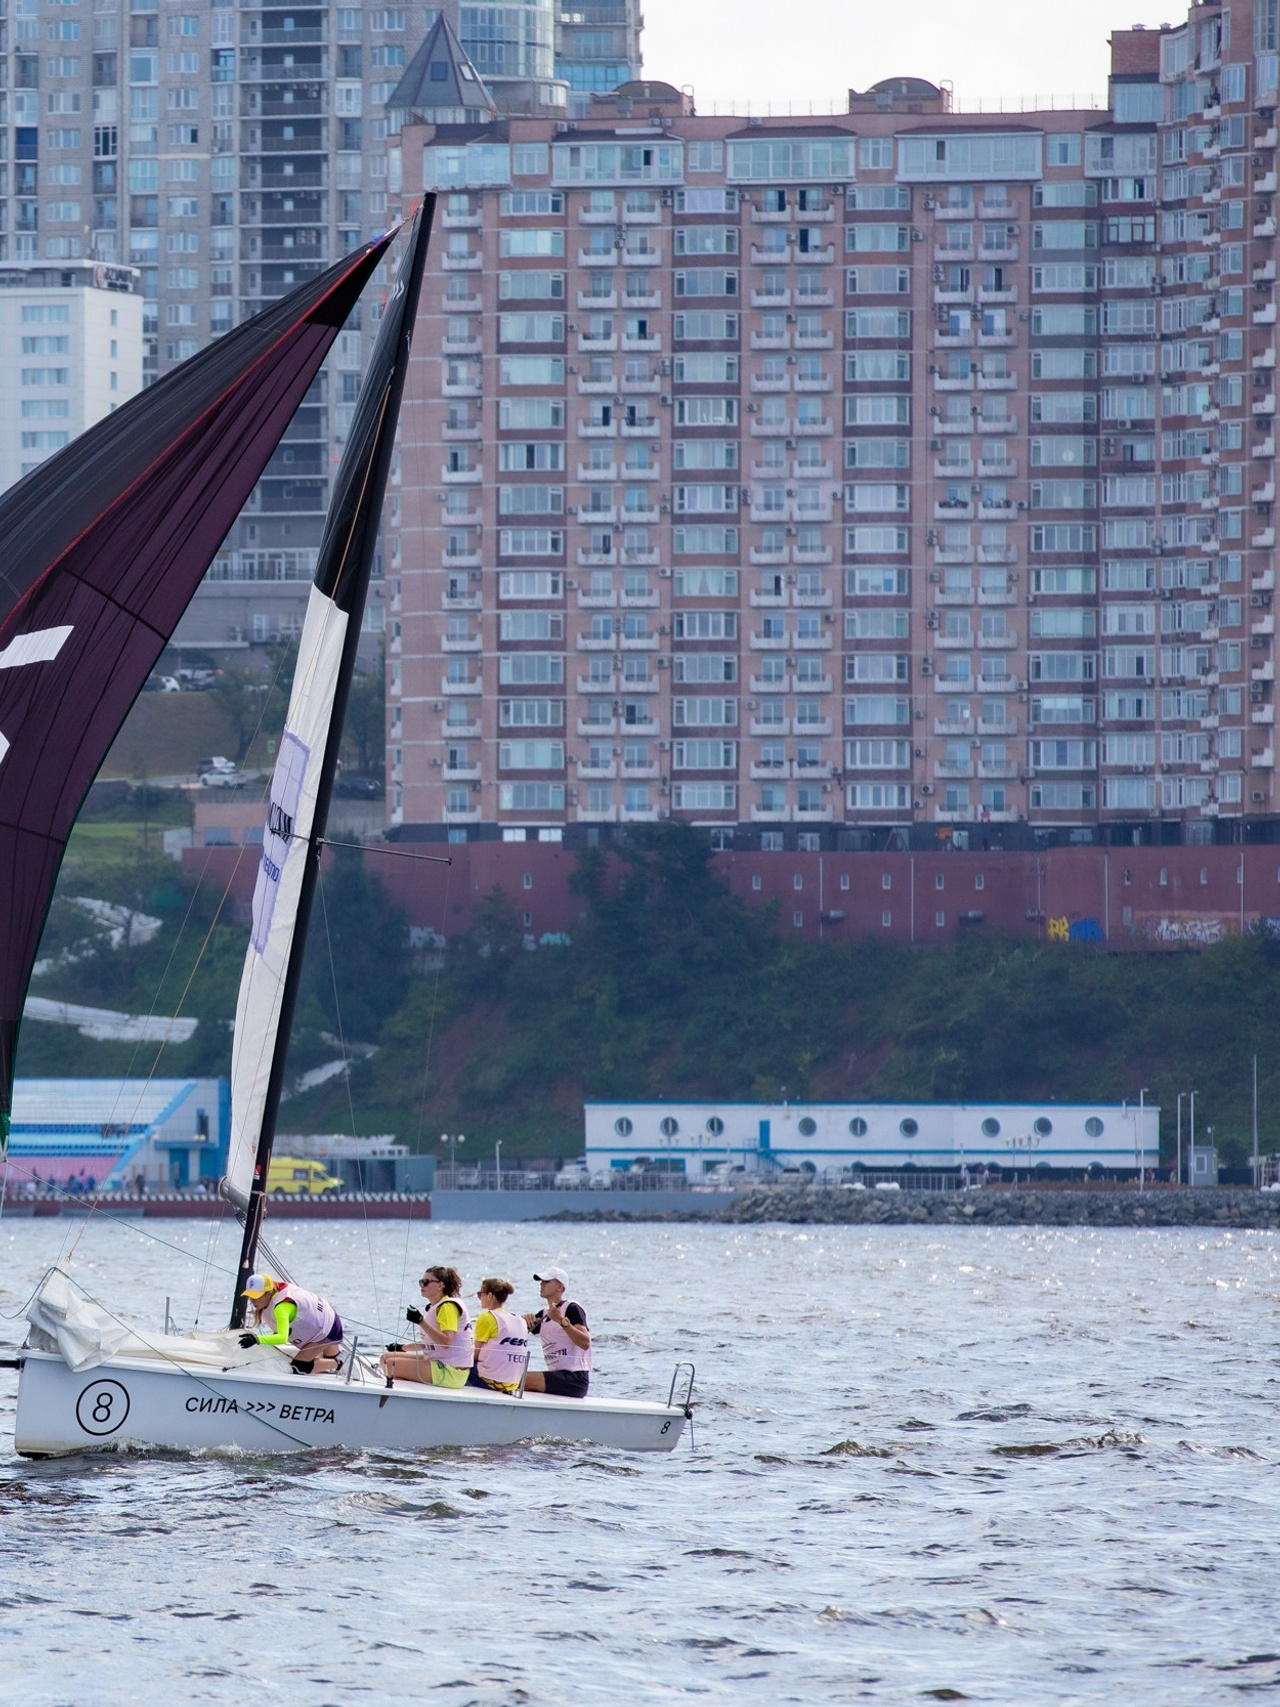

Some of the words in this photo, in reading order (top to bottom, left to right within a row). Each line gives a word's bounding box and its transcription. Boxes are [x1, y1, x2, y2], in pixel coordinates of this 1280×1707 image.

[92, 1392, 114, 1422] 8
[185, 1396, 239, 1414] СИЛА
[279, 1404, 335, 1424] ВЕТРА
[660, 1421, 671, 1435] 8
